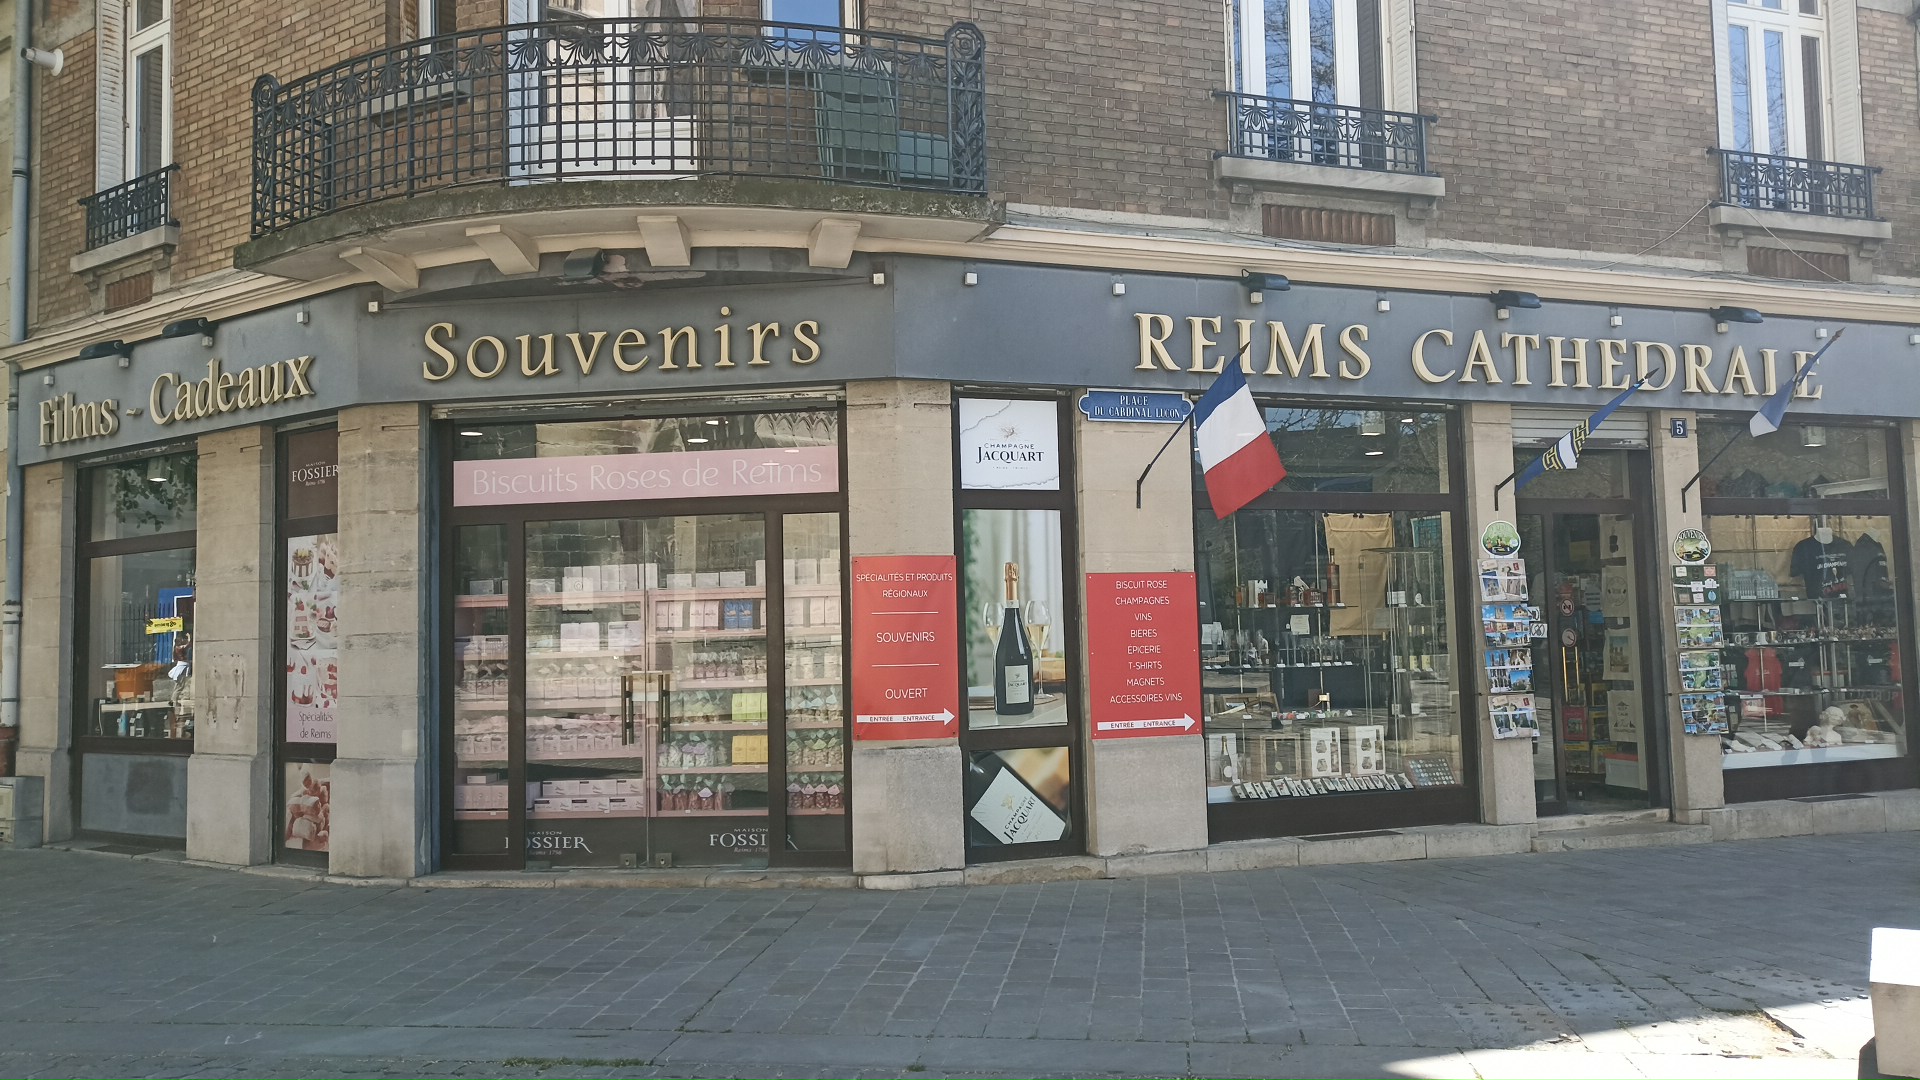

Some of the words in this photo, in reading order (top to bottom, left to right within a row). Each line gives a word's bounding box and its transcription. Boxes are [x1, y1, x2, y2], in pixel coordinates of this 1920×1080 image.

[422, 306, 822, 382] Souvenirs
[1134, 312, 1372, 380] REIMS
[38, 391, 119, 447] Films
[149, 355, 314, 425] Cadeaux
[1120, 395, 1149, 406] PLACE
[1094, 406, 1105, 416] DU
[1108, 406, 1152, 418] CARDINAL
[1676, 421, 1684, 434] 5
[976, 447, 1044, 464] JACQUART
[292, 464, 339, 482] FOSSIER
[472, 468, 578, 496] Biscuits
[590, 464, 672, 491] Roses
[682, 460, 719, 488] de
[732, 457, 822, 485] Reims
[906, 573, 915, 581] ET
[916, 573, 953, 582] PRODUITS
[1115, 580, 1145, 590] BISCUIT
[1147, 580, 1168, 590] ROSE
[882, 589, 928, 598] RÉGIONAUX
[1115, 596, 1170, 606] CHAMPAGNES
[1134, 613, 1153, 621] VINS
[876, 632, 935, 643] SOUVENIRS
[1128, 661, 1163, 670] T-SHIRTS
[1126, 677, 1165, 687] MAGNETS
[885, 687, 928, 699] OUVERT
[1110, 693, 1163, 704] ACCESSOIRES
[1165, 692, 1183, 702] VINS
[298, 711, 334, 726] Spécialités
[903, 714, 935, 722] ENTRANCE
[1143, 720, 1176, 728] ENTRANCE
[299, 727, 309, 739] de
[310, 728, 332, 739] Reims
[1003, 796, 1037, 845] JACQUART
[709, 832, 799, 851] FOSSIR
